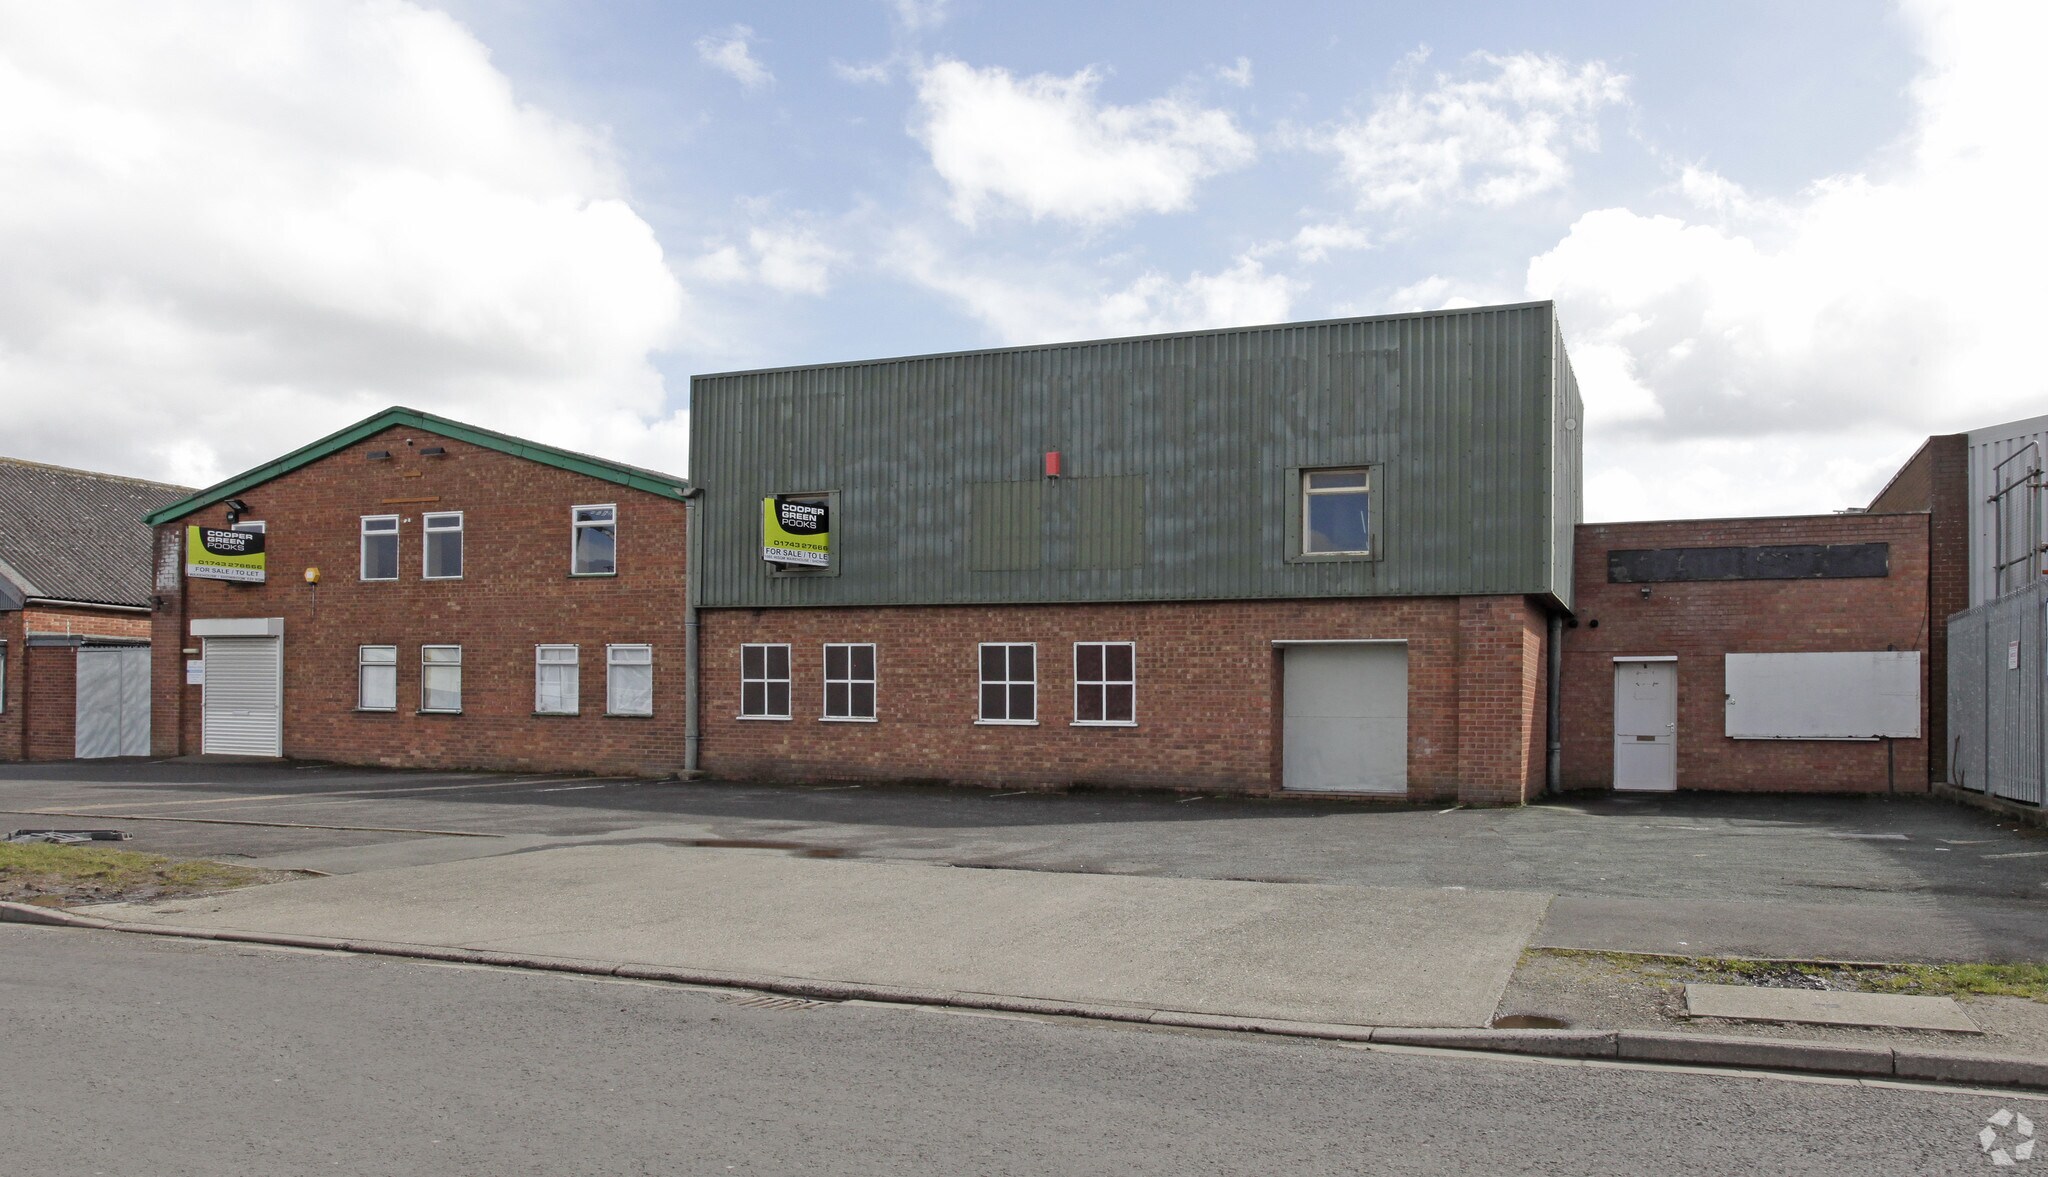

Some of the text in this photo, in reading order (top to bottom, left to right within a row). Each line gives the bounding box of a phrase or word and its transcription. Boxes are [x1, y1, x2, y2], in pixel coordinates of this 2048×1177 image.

[782, 504, 824, 515] COOPER
[782, 511, 817, 521] GREEN
[782, 518, 817, 529] POOKS
[207, 530, 253, 540] COOPER
[207, 536, 245, 545] GREEN
[773, 540, 800, 548] 01743
[207, 543, 245, 551] POOKS
[765, 547, 781, 555] FOR
[783, 549, 802, 558] SALE
[808, 551, 818, 559] TO
[818, 553, 829, 561] LE
